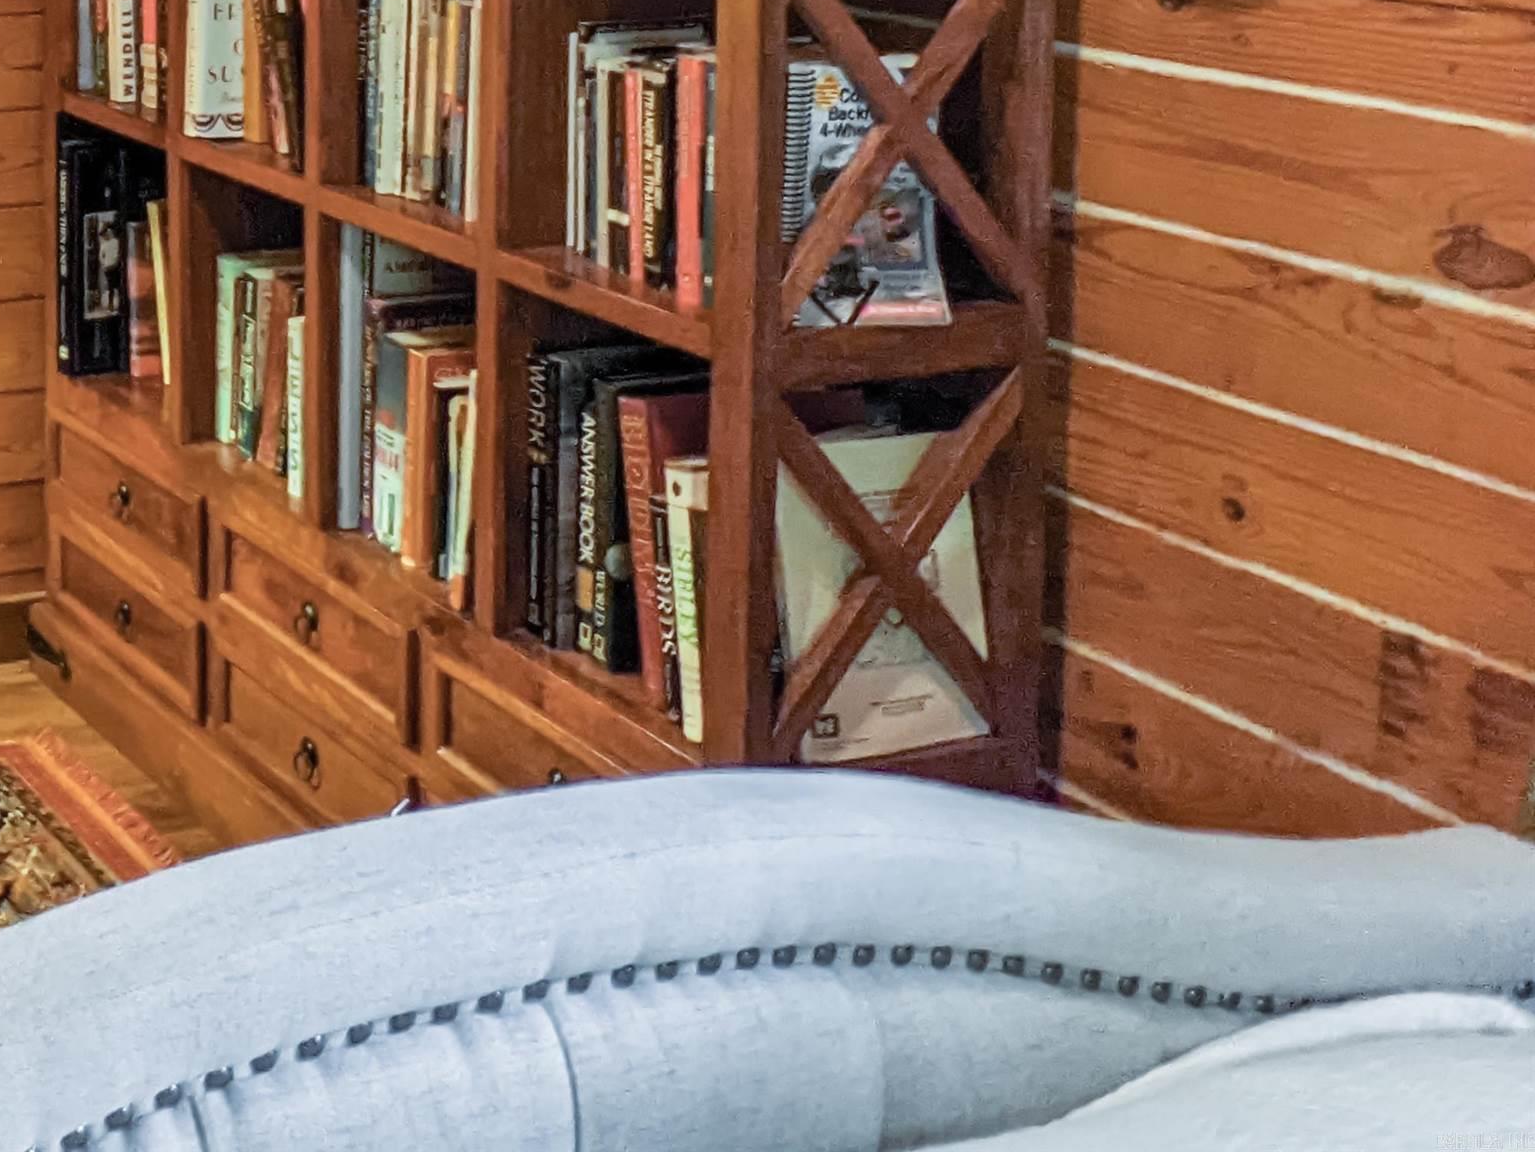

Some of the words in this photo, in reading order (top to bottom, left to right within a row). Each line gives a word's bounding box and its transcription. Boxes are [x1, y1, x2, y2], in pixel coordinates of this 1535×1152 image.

[121, 10, 134, 97] WENDELL
[527, 365, 547, 448] WORK
[580, 412, 597, 498] ANSWER
[578, 501, 596, 565] BOOK
[655, 564, 677, 656] BIRDS
